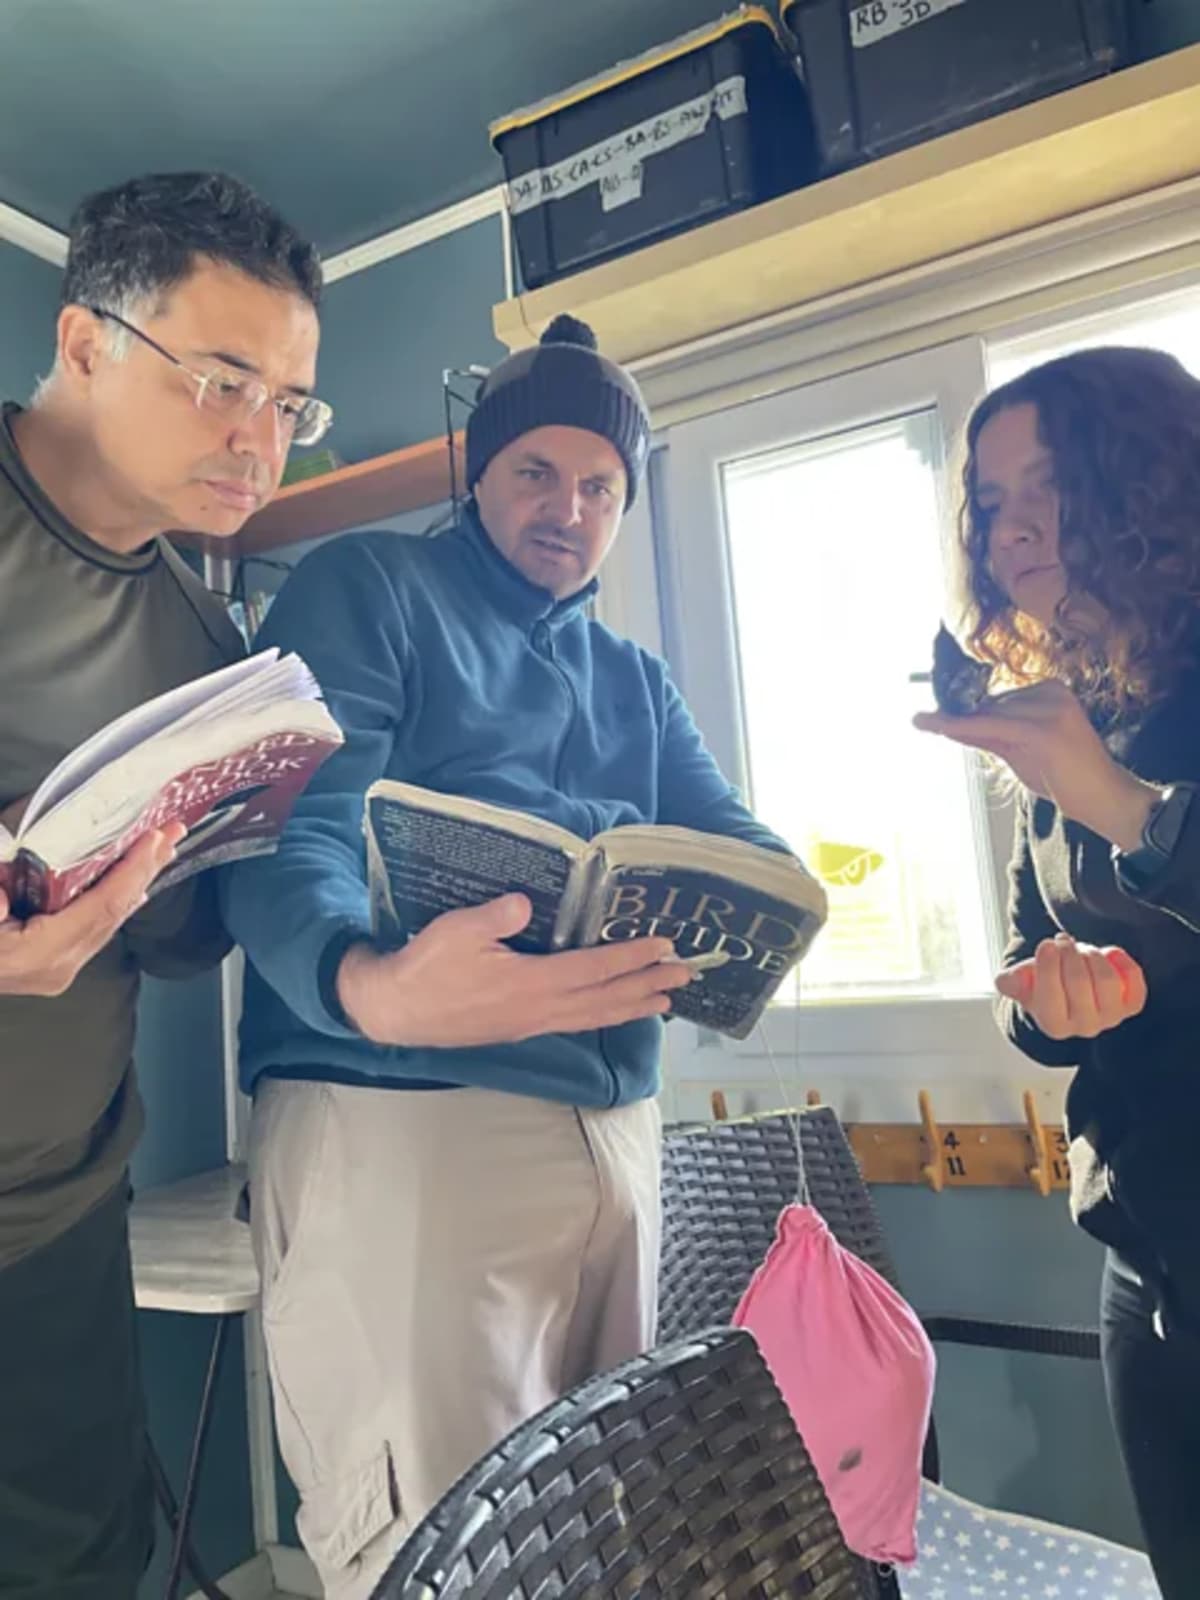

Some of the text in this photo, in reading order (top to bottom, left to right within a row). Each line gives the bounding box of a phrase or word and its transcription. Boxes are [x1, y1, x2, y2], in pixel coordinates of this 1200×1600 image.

[608, 884, 801, 951] BIRD
[601, 917, 790, 975] GUIDE
[944, 1131, 960, 1149] 4
[947, 1156, 966, 1176] 11
